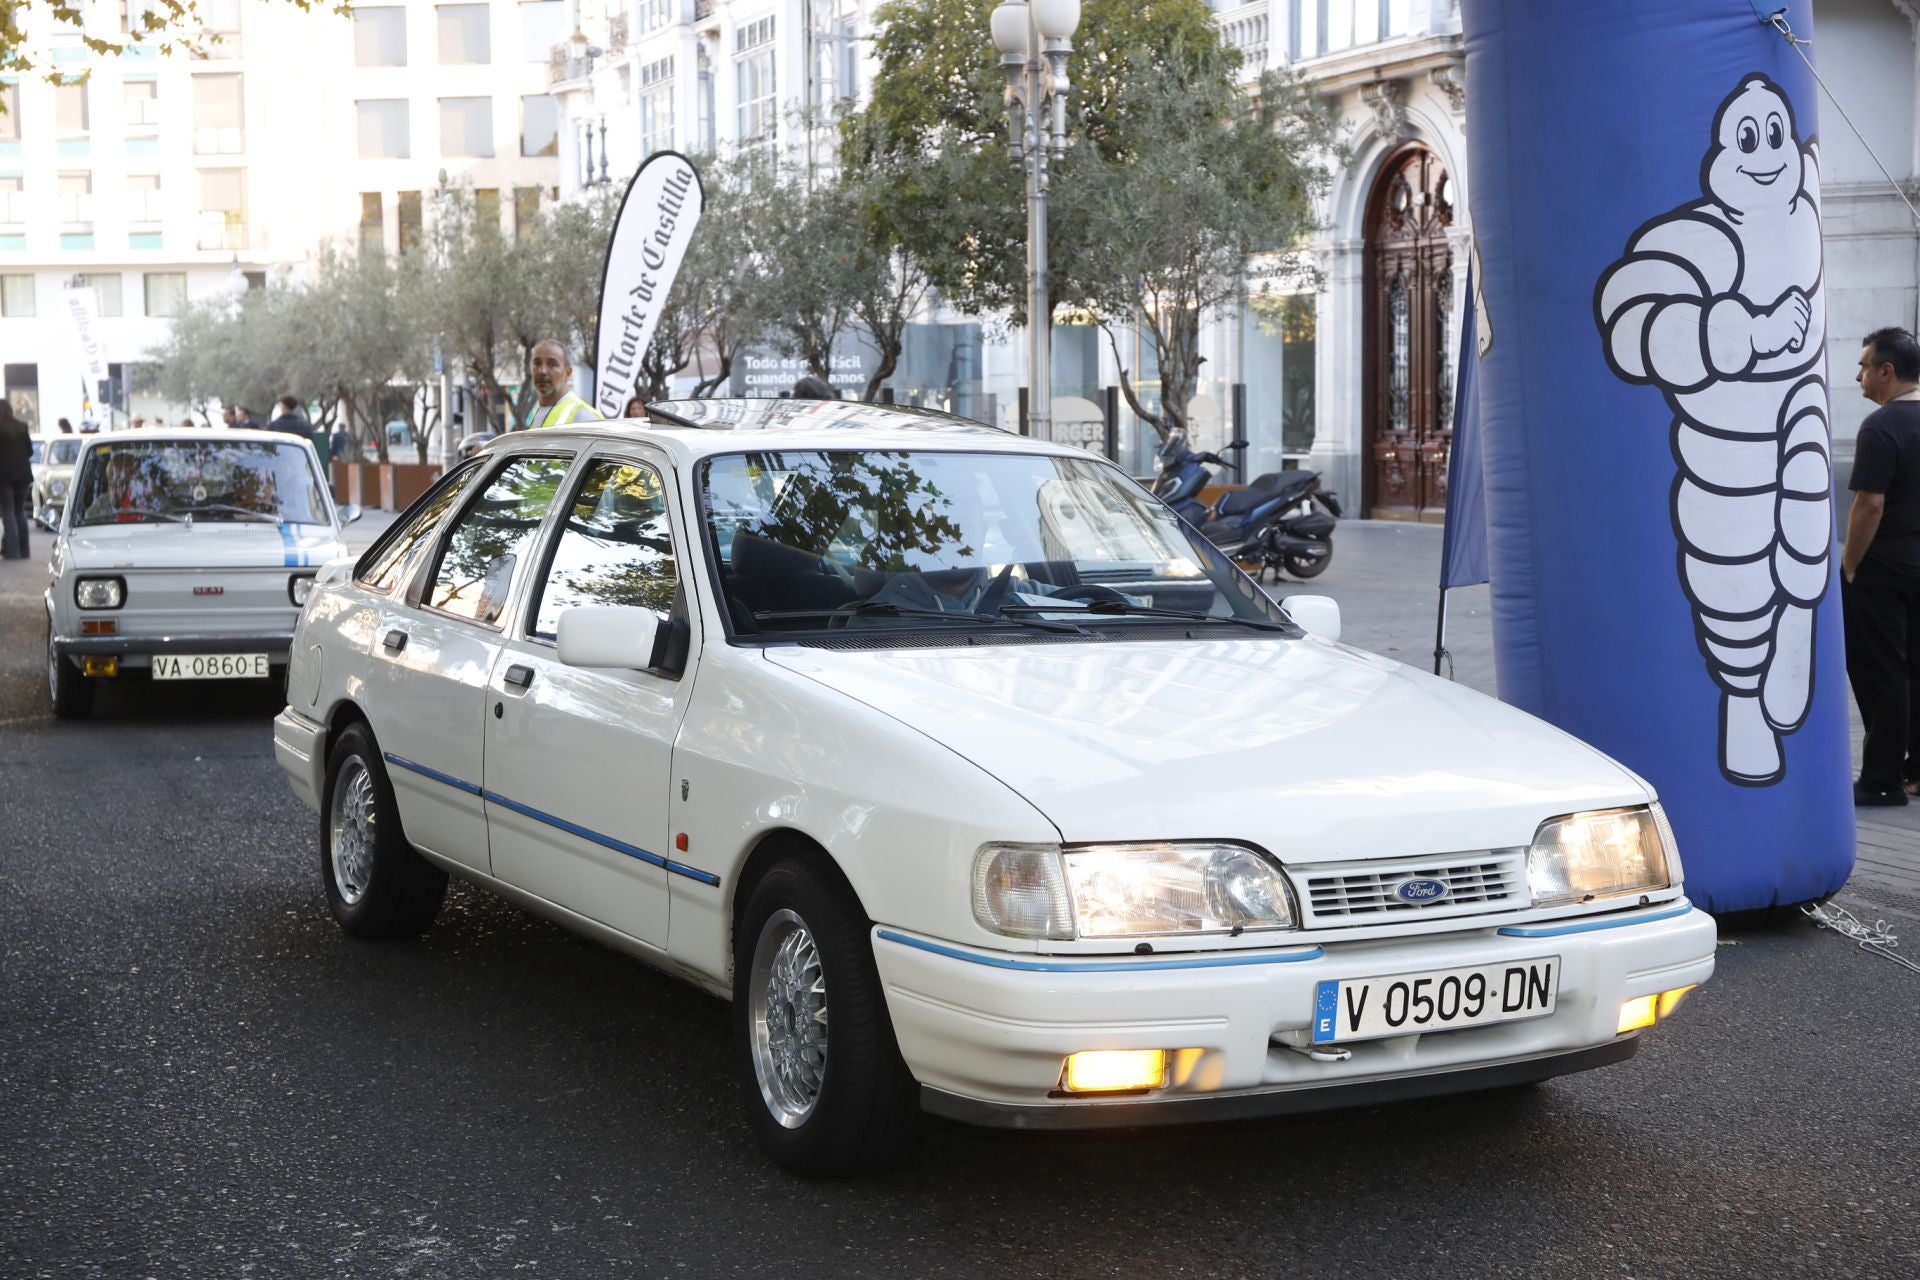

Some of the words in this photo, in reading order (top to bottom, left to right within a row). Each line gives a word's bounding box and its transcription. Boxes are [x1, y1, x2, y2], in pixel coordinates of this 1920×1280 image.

[641, 168, 693, 271] Castilla
[629, 272, 657, 302] de
[605, 304, 646, 379] Norte
[743, 356, 779, 369] Todo
[781, 358, 797, 369] es
[744, 371, 796, 385] cuando
[600, 380, 627, 419] El
[157, 657, 182, 677] VA
[192, 656, 248, 676] 0860
[254, 656, 267, 675] E
[1407, 882, 1436, 898] Ford
[1346, 985, 1369, 1032] V
[1384, 972, 1487, 1027] 0509
[1502, 963, 1552, 1013] DN
[1320, 1018, 1331, 1032] E
